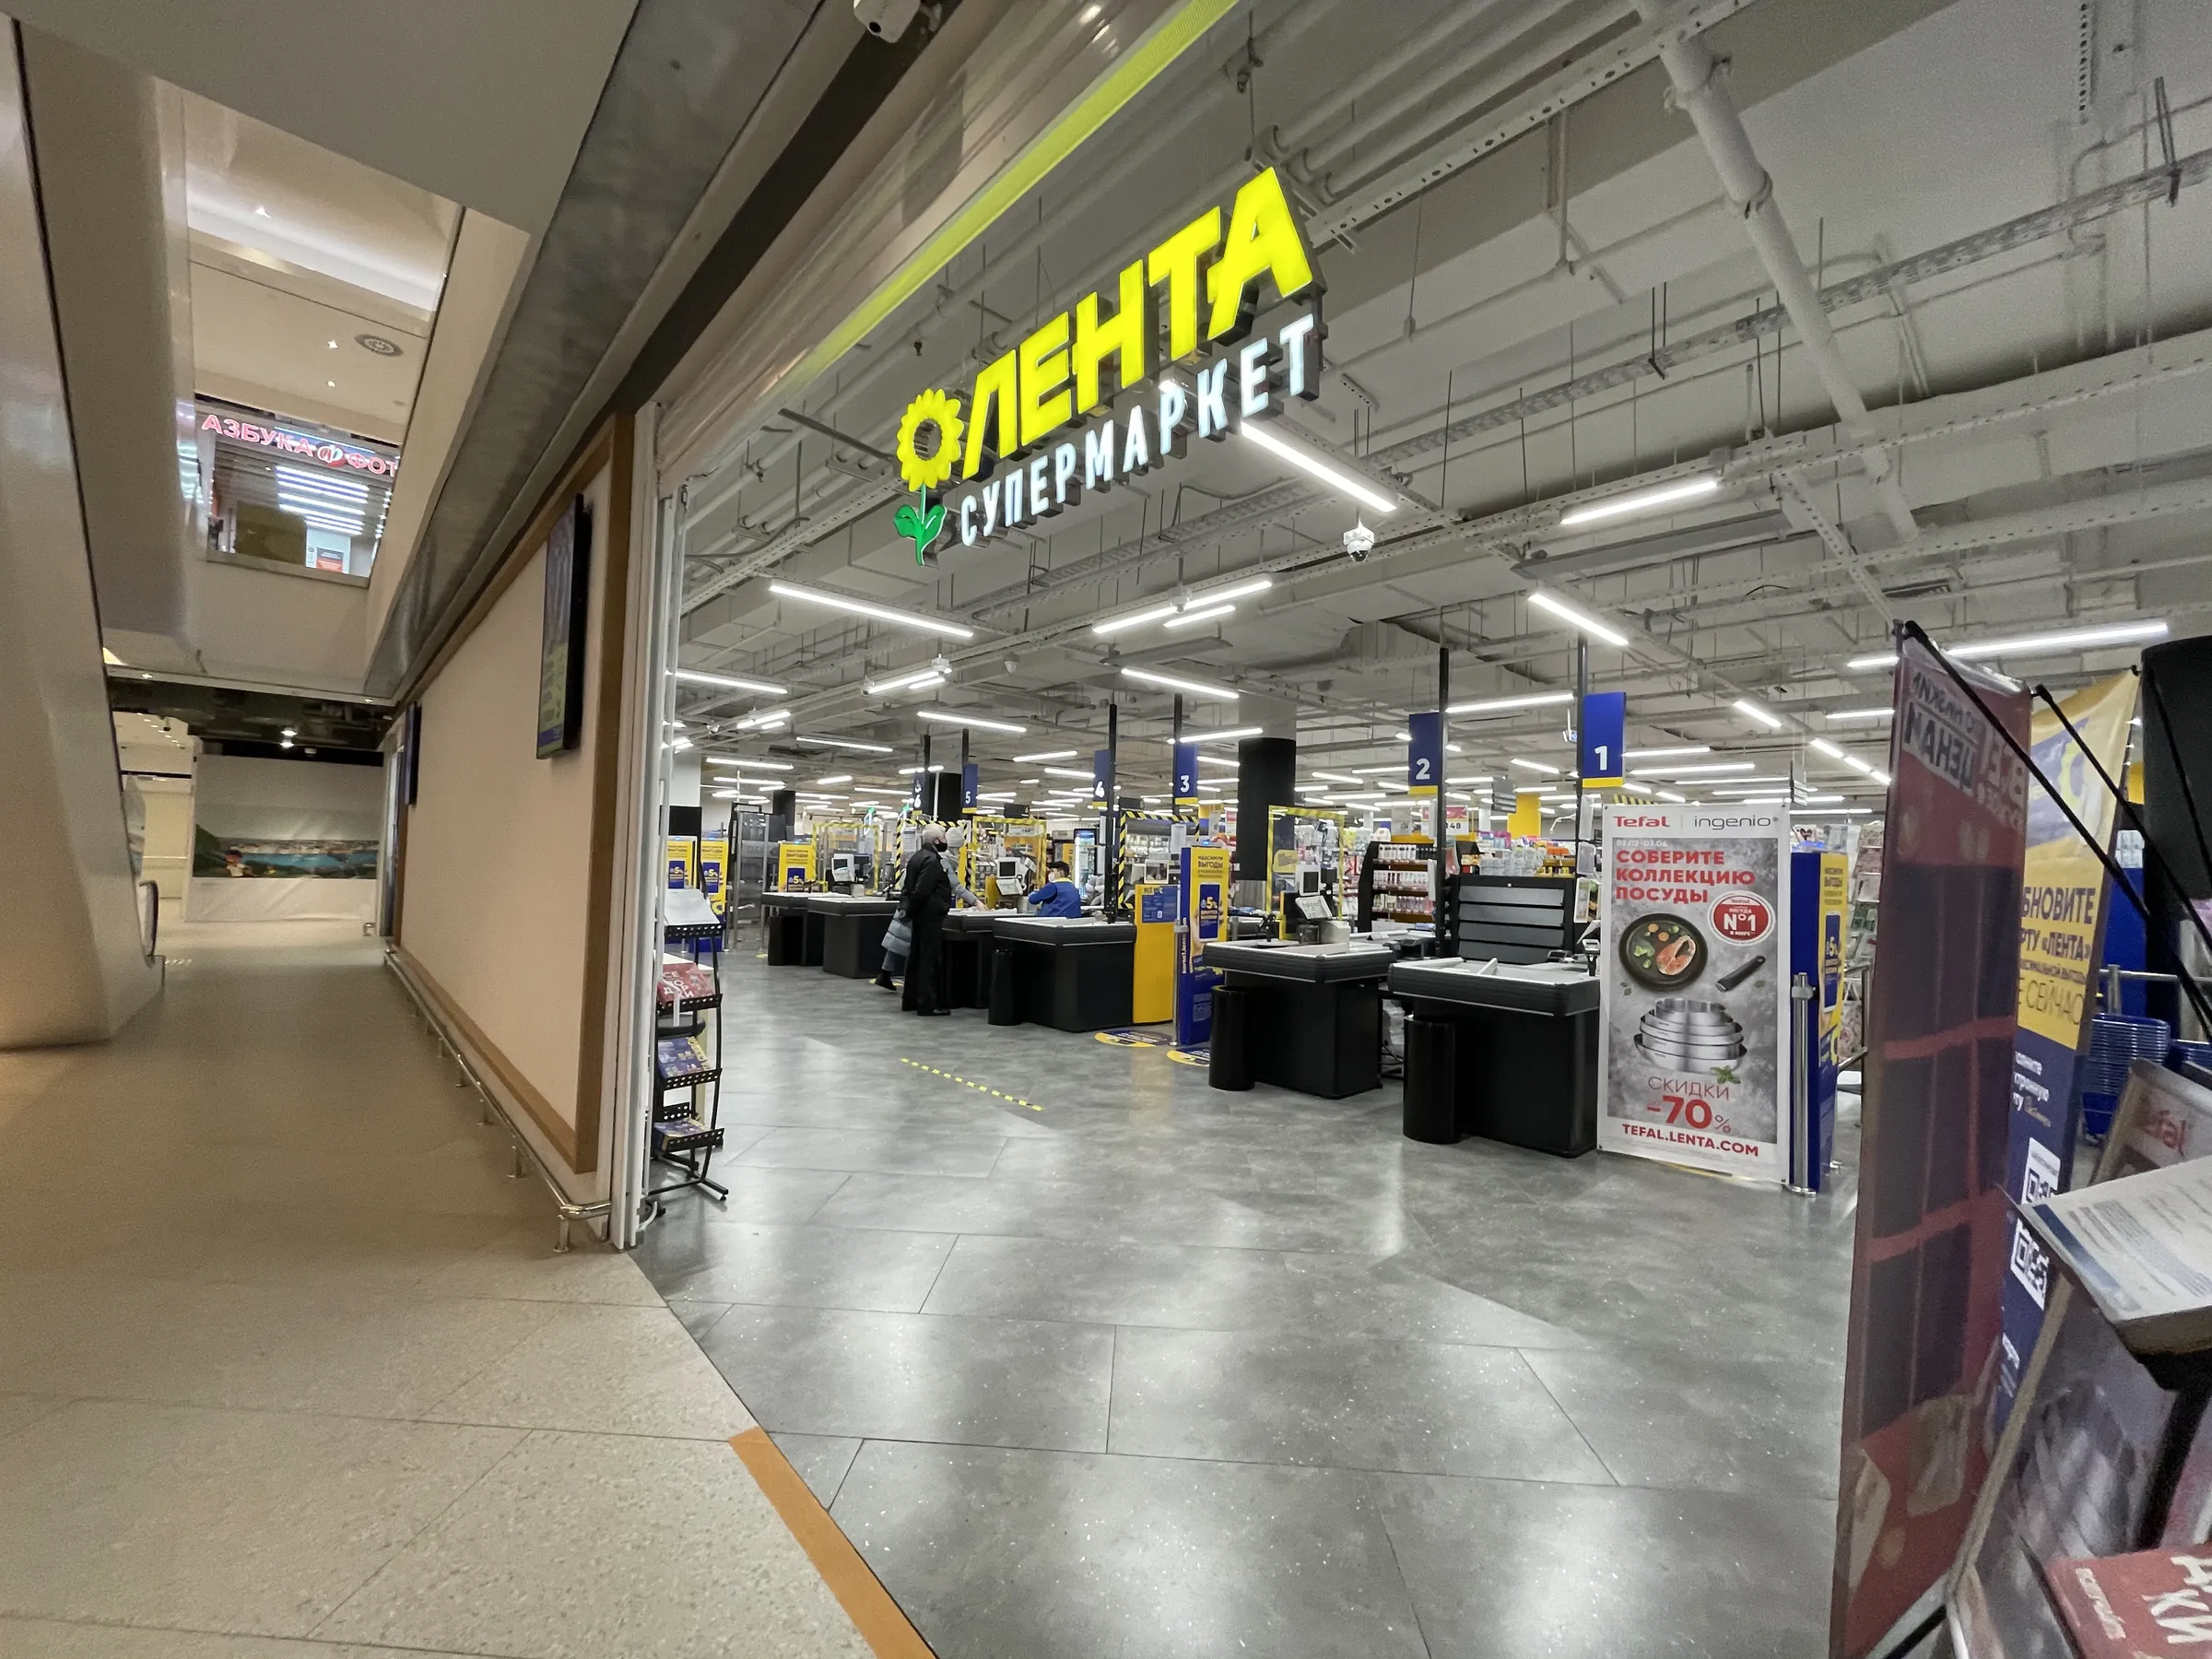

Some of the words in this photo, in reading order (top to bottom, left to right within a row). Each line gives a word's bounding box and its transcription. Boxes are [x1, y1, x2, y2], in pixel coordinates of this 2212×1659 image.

[962, 167, 1313, 481] ЛЕНТА
[201, 414, 313, 457] АЗБУКА
[960, 313, 1315, 547] СУПЕРМАРКЕТ
[1594, 745, 1609, 771] 1
[1415, 758, 1431, 781] 2
[1180, 774, 1191, 793] 3
[913, 794, 922, 808] 6
[965, 791, 972, 805] 5
[1613, 816, 1670, 828] Tefal
[1616, 849, 1725, 865] СОБЕРИТЕ
[1615, 867, 1756, 887] КОЛЛЕКЦИЮ
[1615, 886, 1709, 904] ПОСУДЫ
[1647, 1076, 1730, 1100] СКИДКИ
[1621, 1123, 1759, 1157] TEFAL.LENTA.COM
